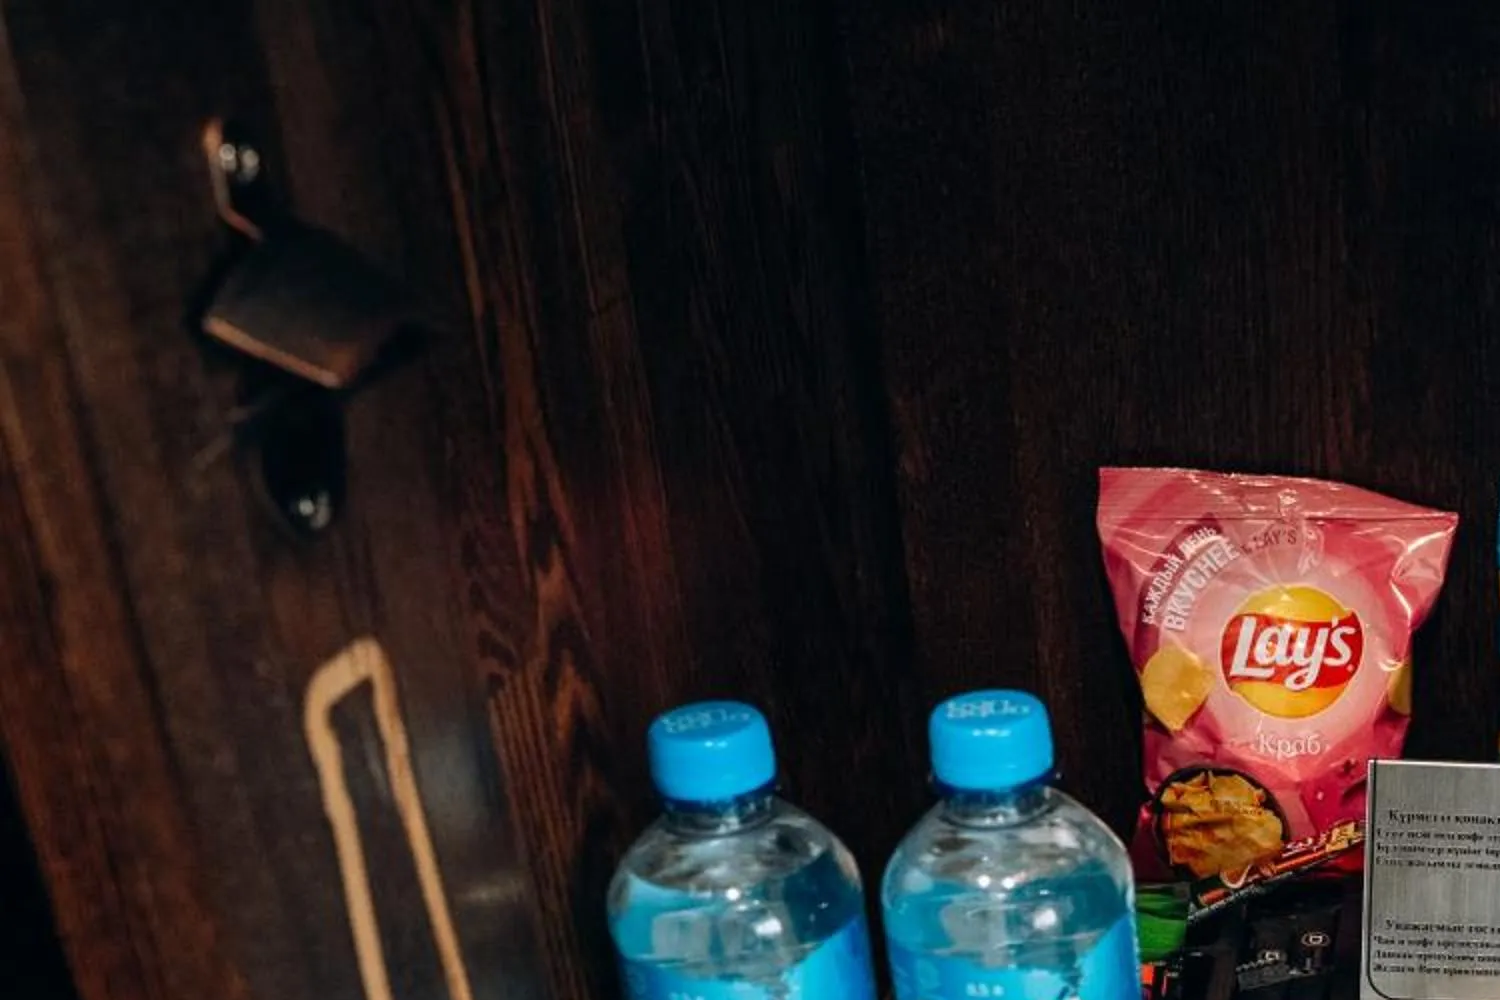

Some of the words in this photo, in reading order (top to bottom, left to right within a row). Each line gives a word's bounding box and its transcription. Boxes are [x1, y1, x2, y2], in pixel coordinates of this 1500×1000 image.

[1164, 536, 1240, 631] ВКУСНЕЕ
[1229, 615, 1356, 691] Lay's
[1257, 730, 1322, 761] Краб
